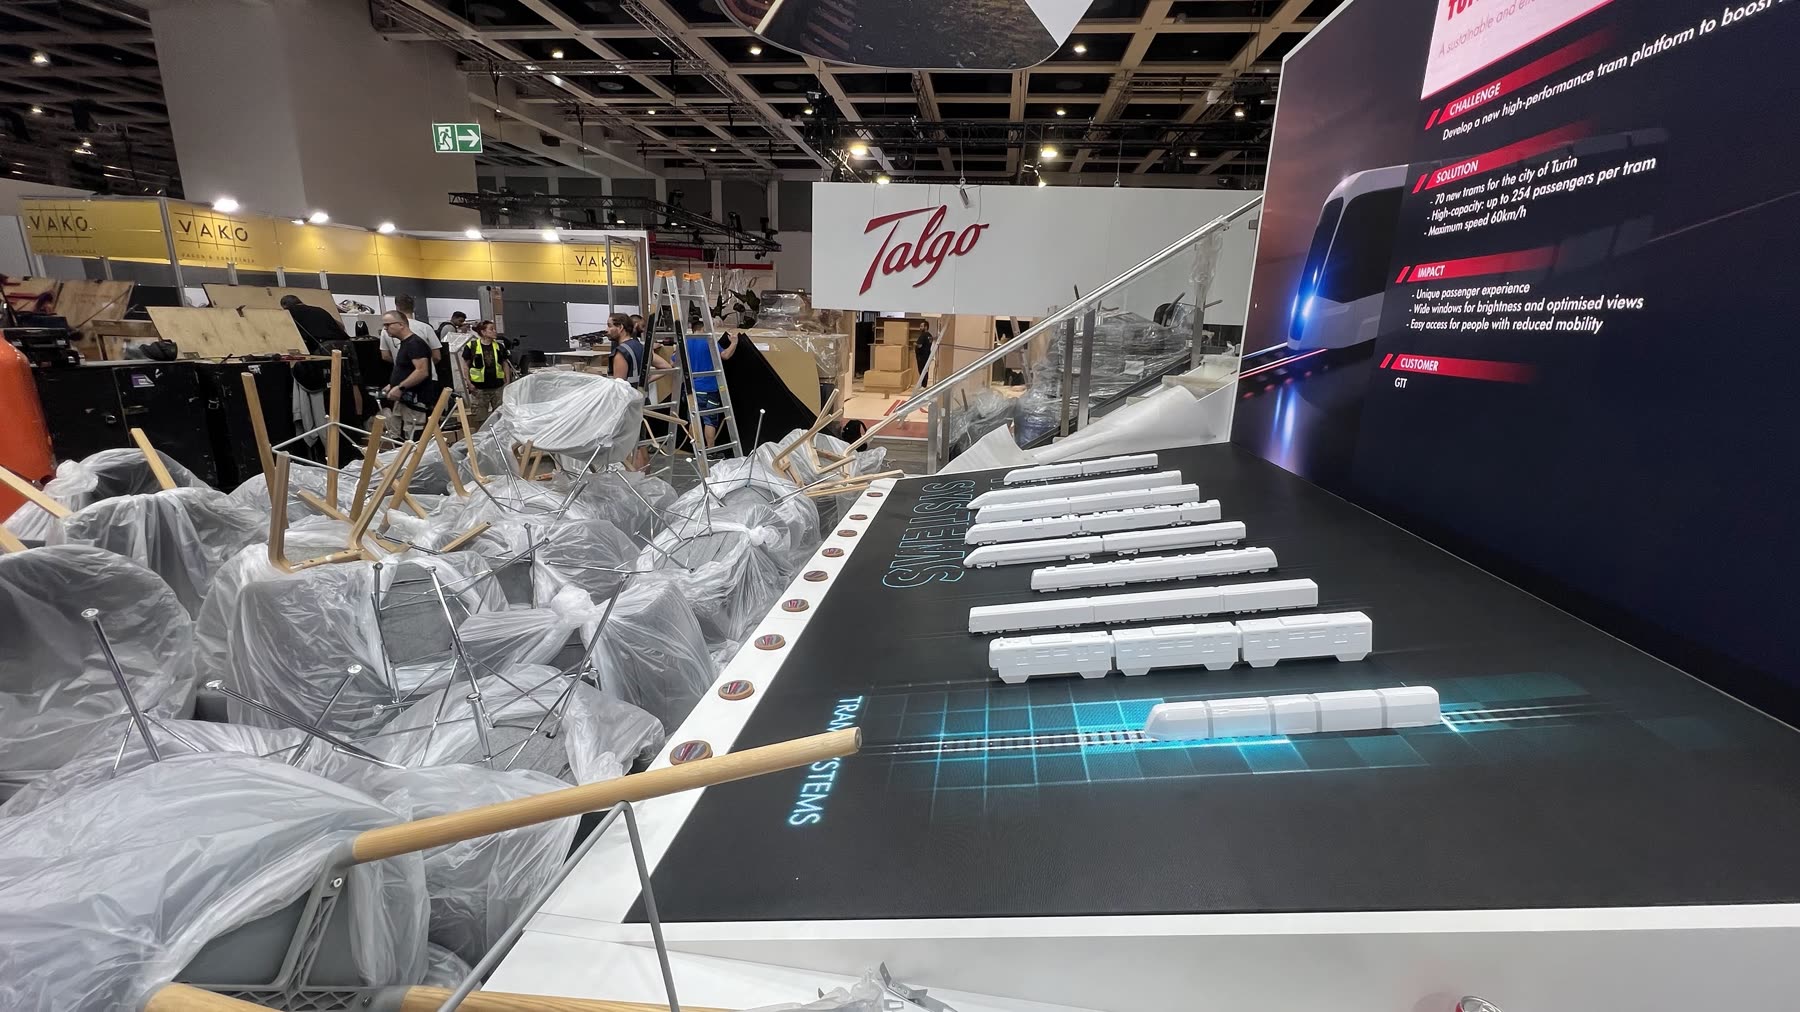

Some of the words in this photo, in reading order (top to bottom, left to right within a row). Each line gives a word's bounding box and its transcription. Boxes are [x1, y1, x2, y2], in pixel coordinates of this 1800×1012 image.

[1446, 12, 1494, 53] sustainable
[1496, 0, 1517, 23] and
[1442, 121, 1473, 141] Develop
[1474, 120, 1481, 128] a
[1482, 110, 1500, 125] new
[1501, 69, 1594, 117] high-performance
[1597, 56, 1628, 77] tram
[1630, 27, 1695, 67] platform
[1699, 18, 1716, 36] to
[1449, 82, 1501, 116] CHALLENGE
[1435, 193, 1445, 206] 70
[1445, 190, 1461, 202] new
[1462, 184, 1485, 197] trams
[1486, 178, 1501, 191] for
[1501, 173, 1517, 187] the
[1518, 168, 1535, 184] city
[1537, 161, 1551, 178] of
[1551, 155, 1578, 174] Turin
[1436, 159, 1479, 184] SOLUTION
[1431, 200, 1485, 222] High-capacity:
[1486, 197, 1498, 210] up
[1500, 193, 1509, 205] to
[1510, 185, 1532, 203] 254
[1532, 172, 1595, 200] passengers
[1596, 166, 1621, 185] per
[1622, 157, 1657, 176] tram
[29, 215, 88, 232] VAKO
[178, 219, 249, 242] VAKO
[1427, 222, 1463, 237] Maximum
[1464, 212, 1490, 232] speed
[1490, 204, 1527, 224] 60km/h
[575, 255, 623, 268] VAKO
[859, 204, 989, 296] Talgo
[1417, 265, 1445, 278] IMPACT
[1416, 288, 1440, 301] Unique
[1441, 287, 1481, 300] passenger
[1481, 281, 1530, 298] experience
[1413, 303, 1431, 314] Wide
[1431, 302, 1462, 314] windows
[1463, 301, 1476, 313] for
[1476, 299, 1522, 316] brightness
[1524, 297, 1546, 312] and
[1546, 294, 1605, 315] optimised
[1606, 293, 1645, 310] views
[1410, 318, 1426, 332] Easy
[1425, 320, 1448, 330] access
[1448, 317, 1460, 330] for
[1461, 317, 1489, 333] people
[1491, 316, 1510, 330] with
[1512, 316, 1555, 331] reduced
[1555, 315, 1604, 335] mobility
[1400, 357, 1439, 372] CUSTOMER
[1394, 377, 1408, 389] GTT
[788, 757, 841, 826] STEMS
